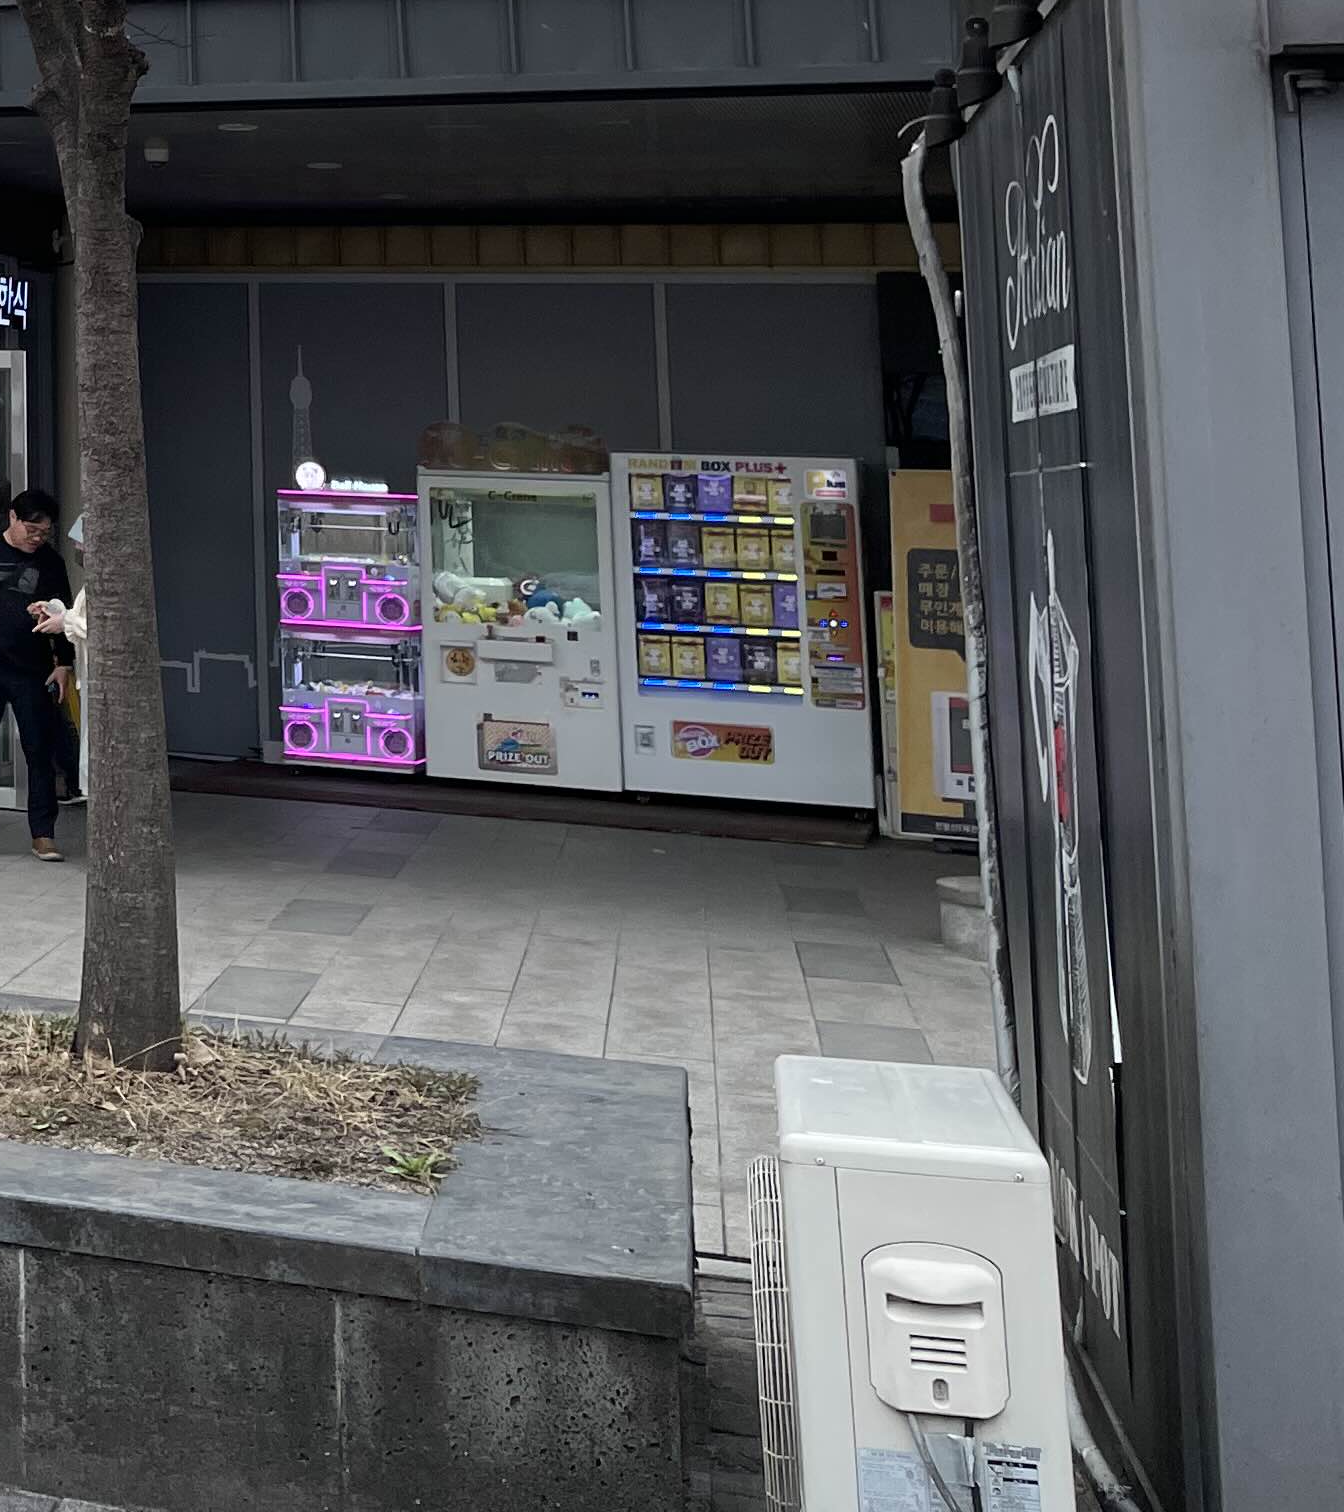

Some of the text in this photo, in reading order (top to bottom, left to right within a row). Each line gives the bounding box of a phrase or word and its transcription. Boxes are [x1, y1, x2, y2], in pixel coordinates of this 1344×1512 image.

[700, 460, 732, 473] BOX
[487, 750, 551, 765] PRIZE OUT
